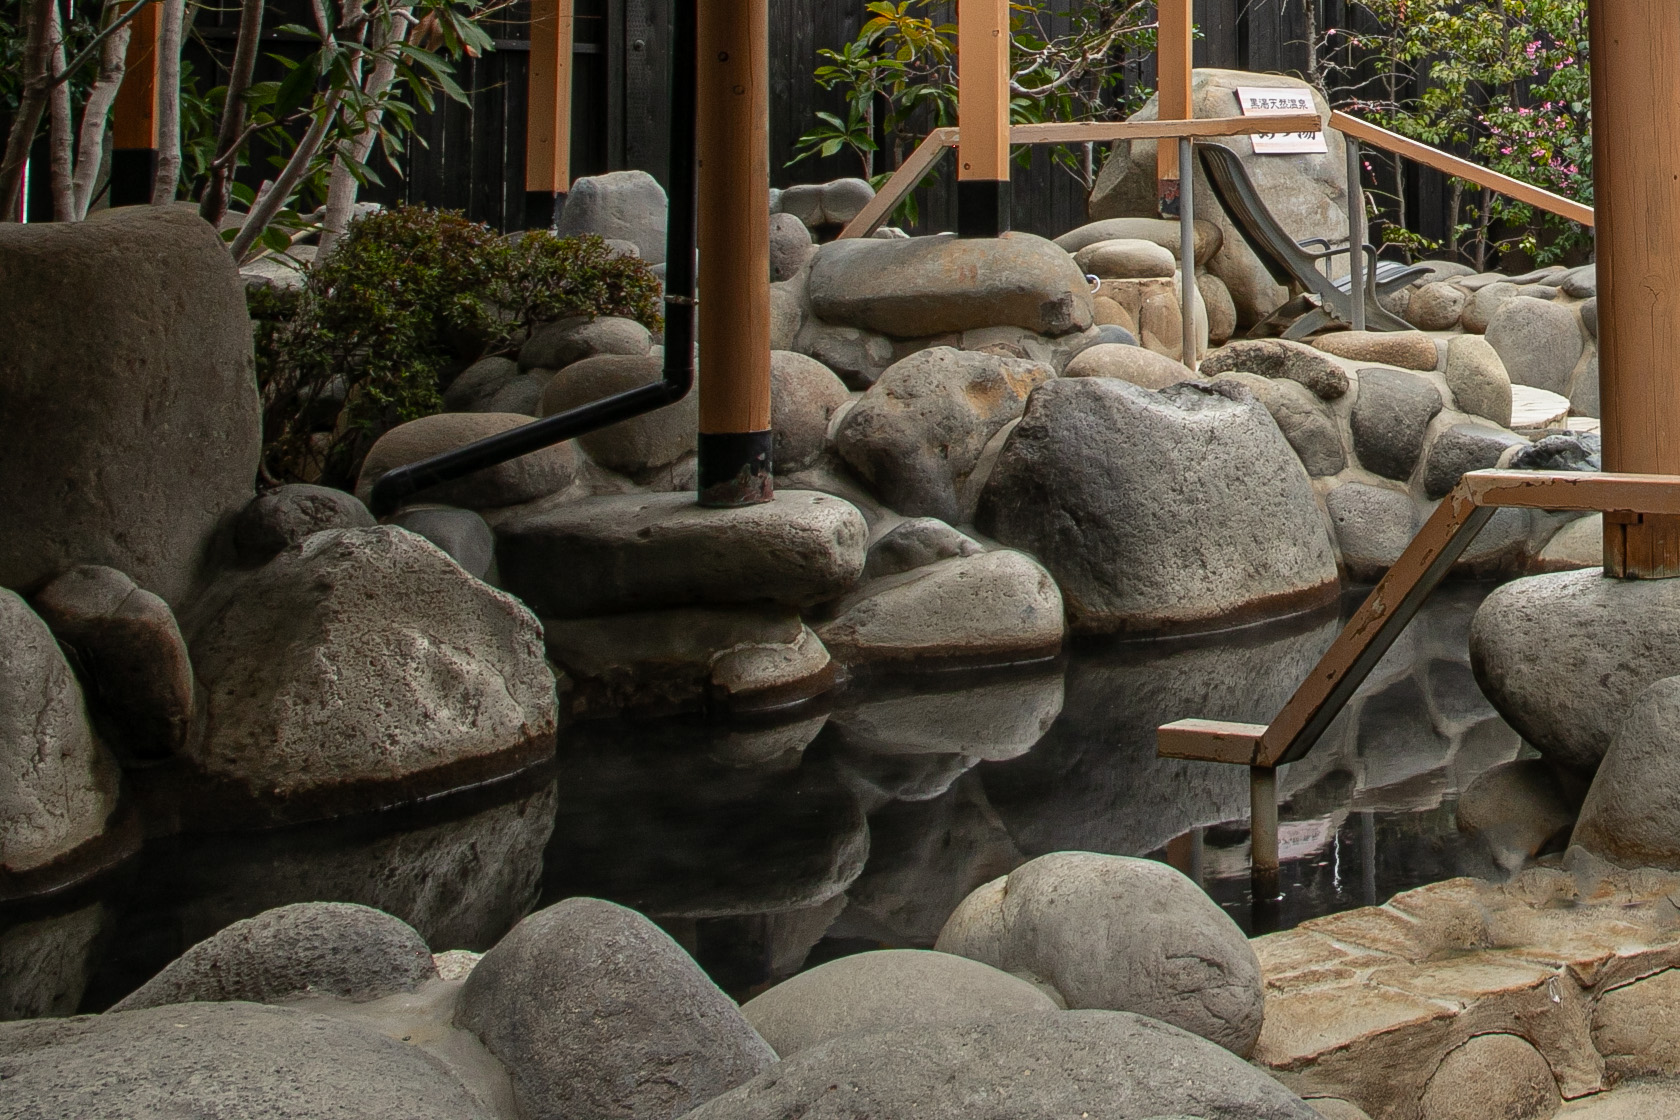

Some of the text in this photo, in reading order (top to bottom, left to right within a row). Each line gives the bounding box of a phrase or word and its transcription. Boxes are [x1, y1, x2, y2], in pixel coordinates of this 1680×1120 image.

[1249, 97, 1308, 110] 黒湯天然温泉
